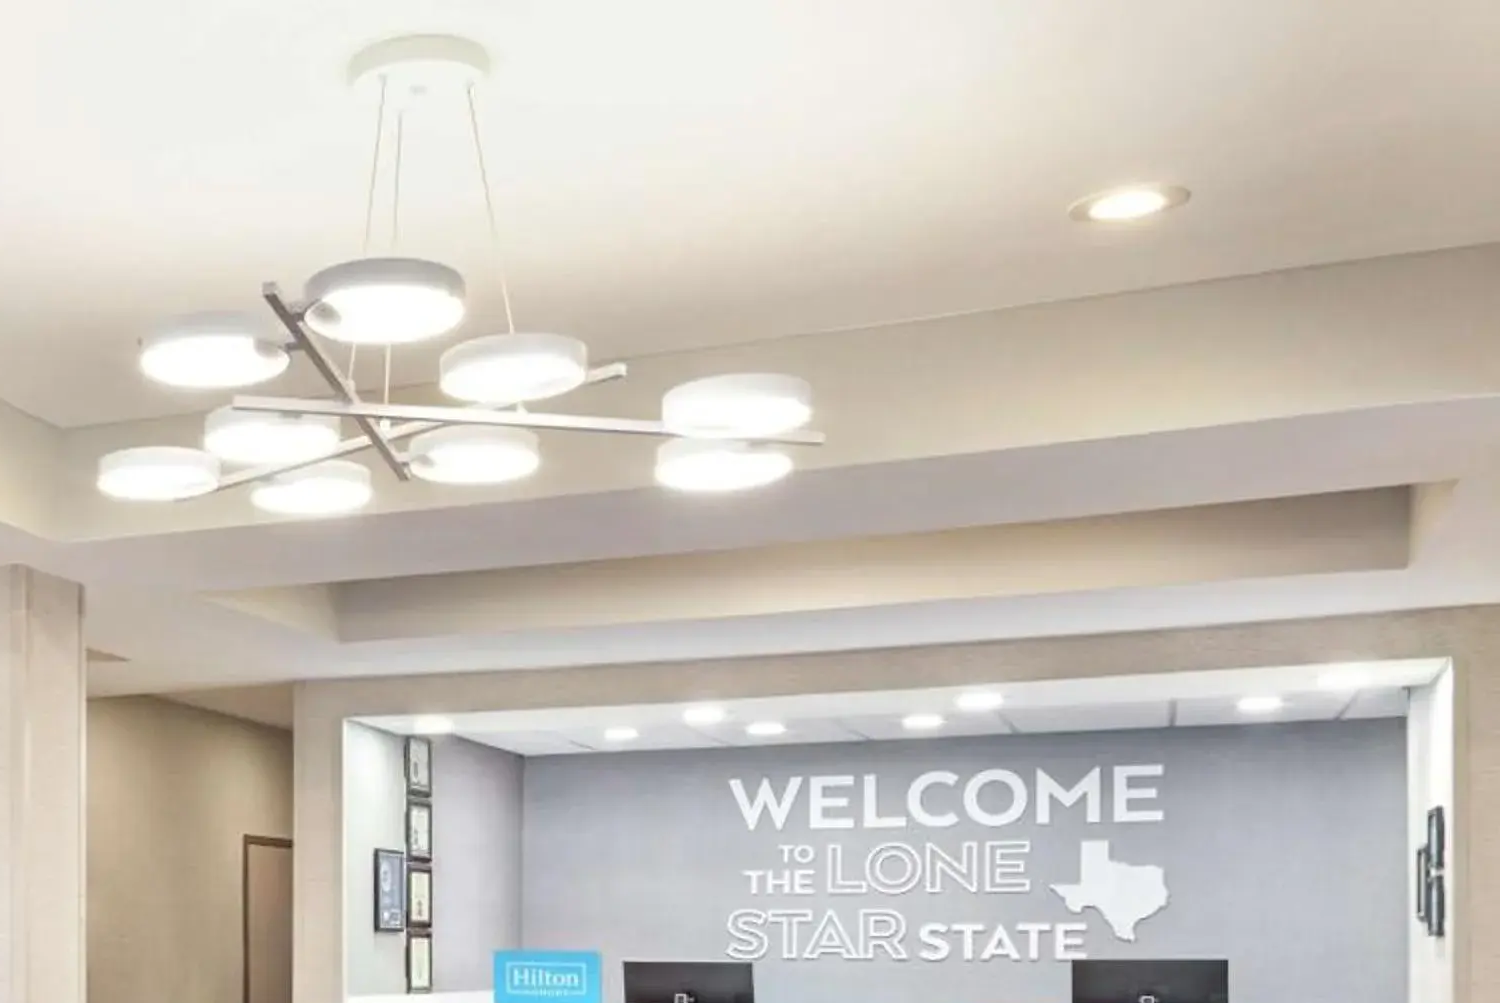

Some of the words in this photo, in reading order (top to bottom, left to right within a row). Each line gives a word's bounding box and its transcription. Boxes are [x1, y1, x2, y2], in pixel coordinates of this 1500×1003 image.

[728, 763, 1165, 831] WELCOME
[742, 869, 817, 895] THE
[827, 840, 1031, 895] LONE
[778, 844, 815, 864] TO
[725, 908, 908, 960] STAR
[918, 922, 1088, 961] STATE
[512, 967, 579, 987] Hilton
